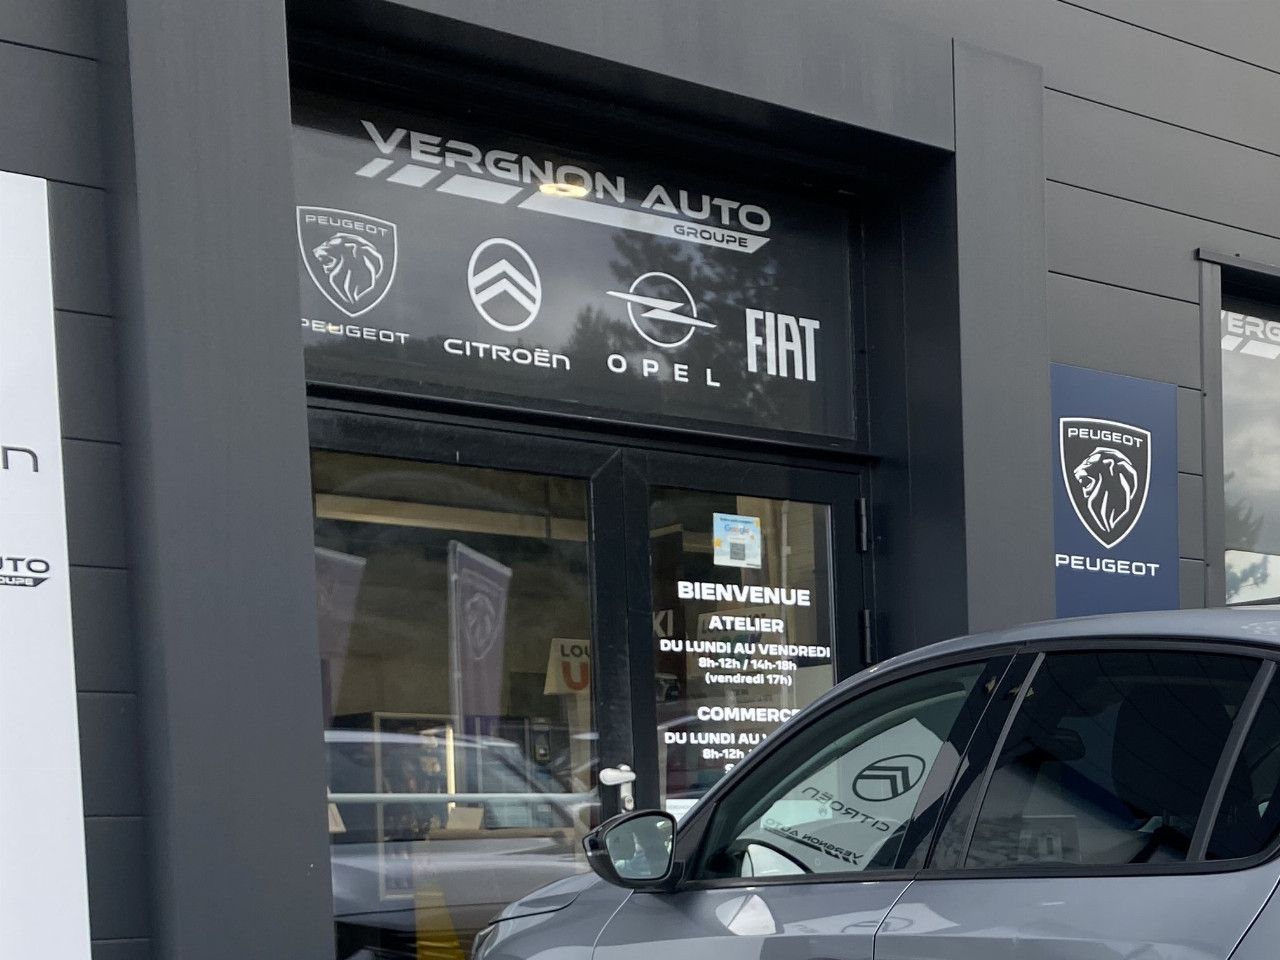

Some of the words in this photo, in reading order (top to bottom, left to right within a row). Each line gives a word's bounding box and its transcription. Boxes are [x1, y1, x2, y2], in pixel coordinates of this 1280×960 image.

[360, 119, 625, 203] VERGNON
[640, 184, 771, 231] AUTO
[305, 214, 388, 236] PEUGEOT
[673, 224, 749, 248] GROUPE
[745, 308, 820, 381] FIAT
[607, 353, 721, 387] OPEL
[1067, 427, 1144, 448] PEUGEOT
[0, 556, 50, 573] TO
[1055, 553, 1160, 577] PEUGEOT
[677, 580, 811, 606] BIENVENUE
[708, 615, 784, 634] ATELIER
[660, 638, 683, 652] DU
[685, 640, 731, 654] LUNDI
[733, 642, 756, 655] AU
[758, 643, 831, 658] VENDREDI
[698, 657, 741, 670] 8h-12h
[751, 658, 797, 671] 14h-18h
[705, 672, 764, 685] (vendredi
[766, 674, 793, 686] 17h)
[664, 731, 687, 744] DU
[690, 732, 735, 745] LUNDI
[738, 733, 760, 745] AU
[702, 748, 744, 760] 8h-12h
